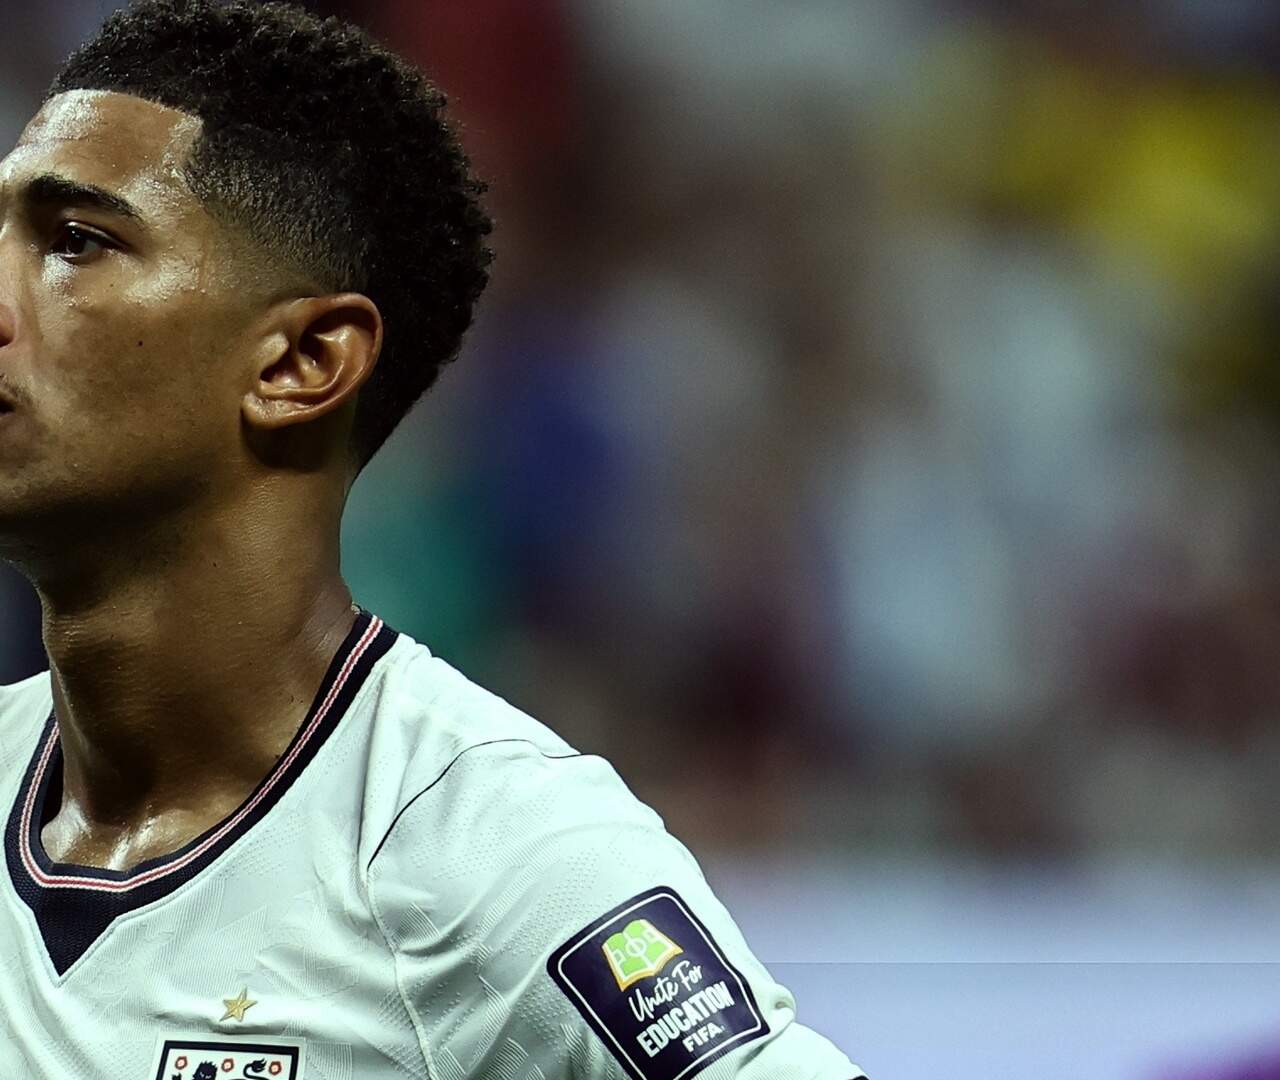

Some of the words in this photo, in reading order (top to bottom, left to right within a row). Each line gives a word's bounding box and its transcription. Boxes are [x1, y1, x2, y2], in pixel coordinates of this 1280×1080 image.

[628, 977, 679, 1022] Unite
[671, 960, 703, 992] For
[636, 981, 735, 1058] EDUCATION
[682, 1022, 724, 1053] FIFA
